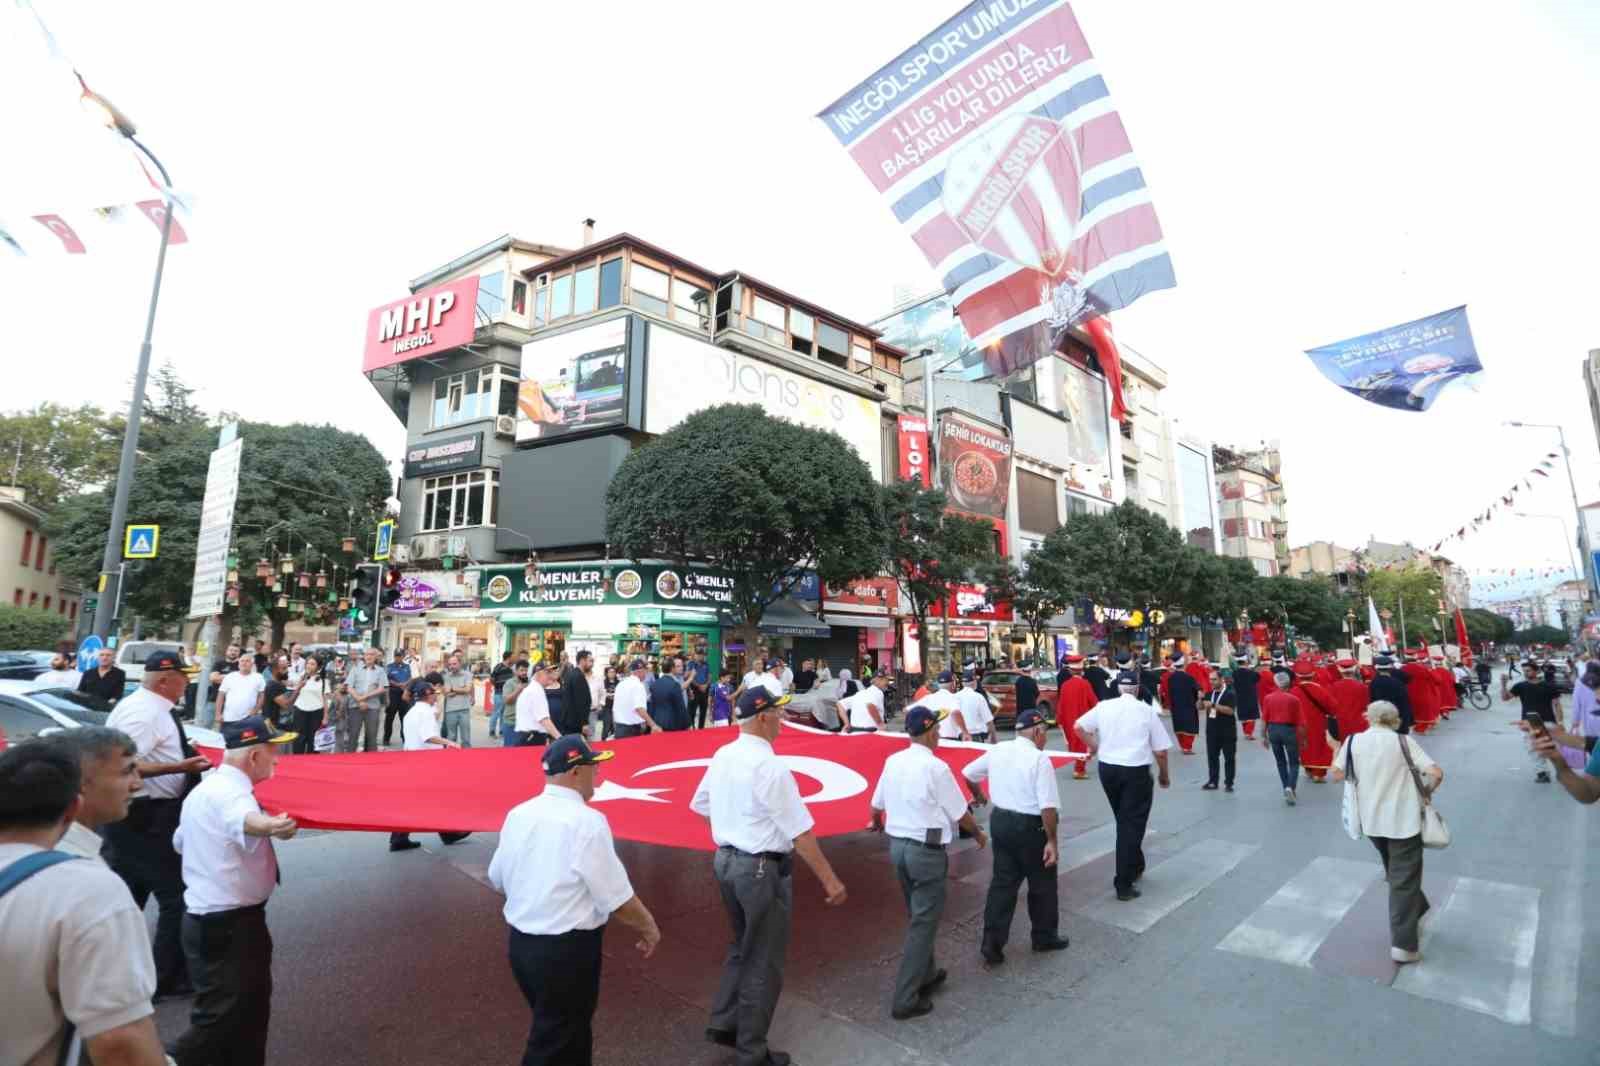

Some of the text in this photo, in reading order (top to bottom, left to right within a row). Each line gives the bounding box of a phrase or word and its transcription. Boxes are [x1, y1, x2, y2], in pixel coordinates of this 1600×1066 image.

[933, 43, 1036, 112] YOLUNDA
[880, 44, 1072, 178] BAŞARILAR DİLERİZ
[379, 291, 455, 342] MHP
[393, 330, 434, 354] İNEGÖL
